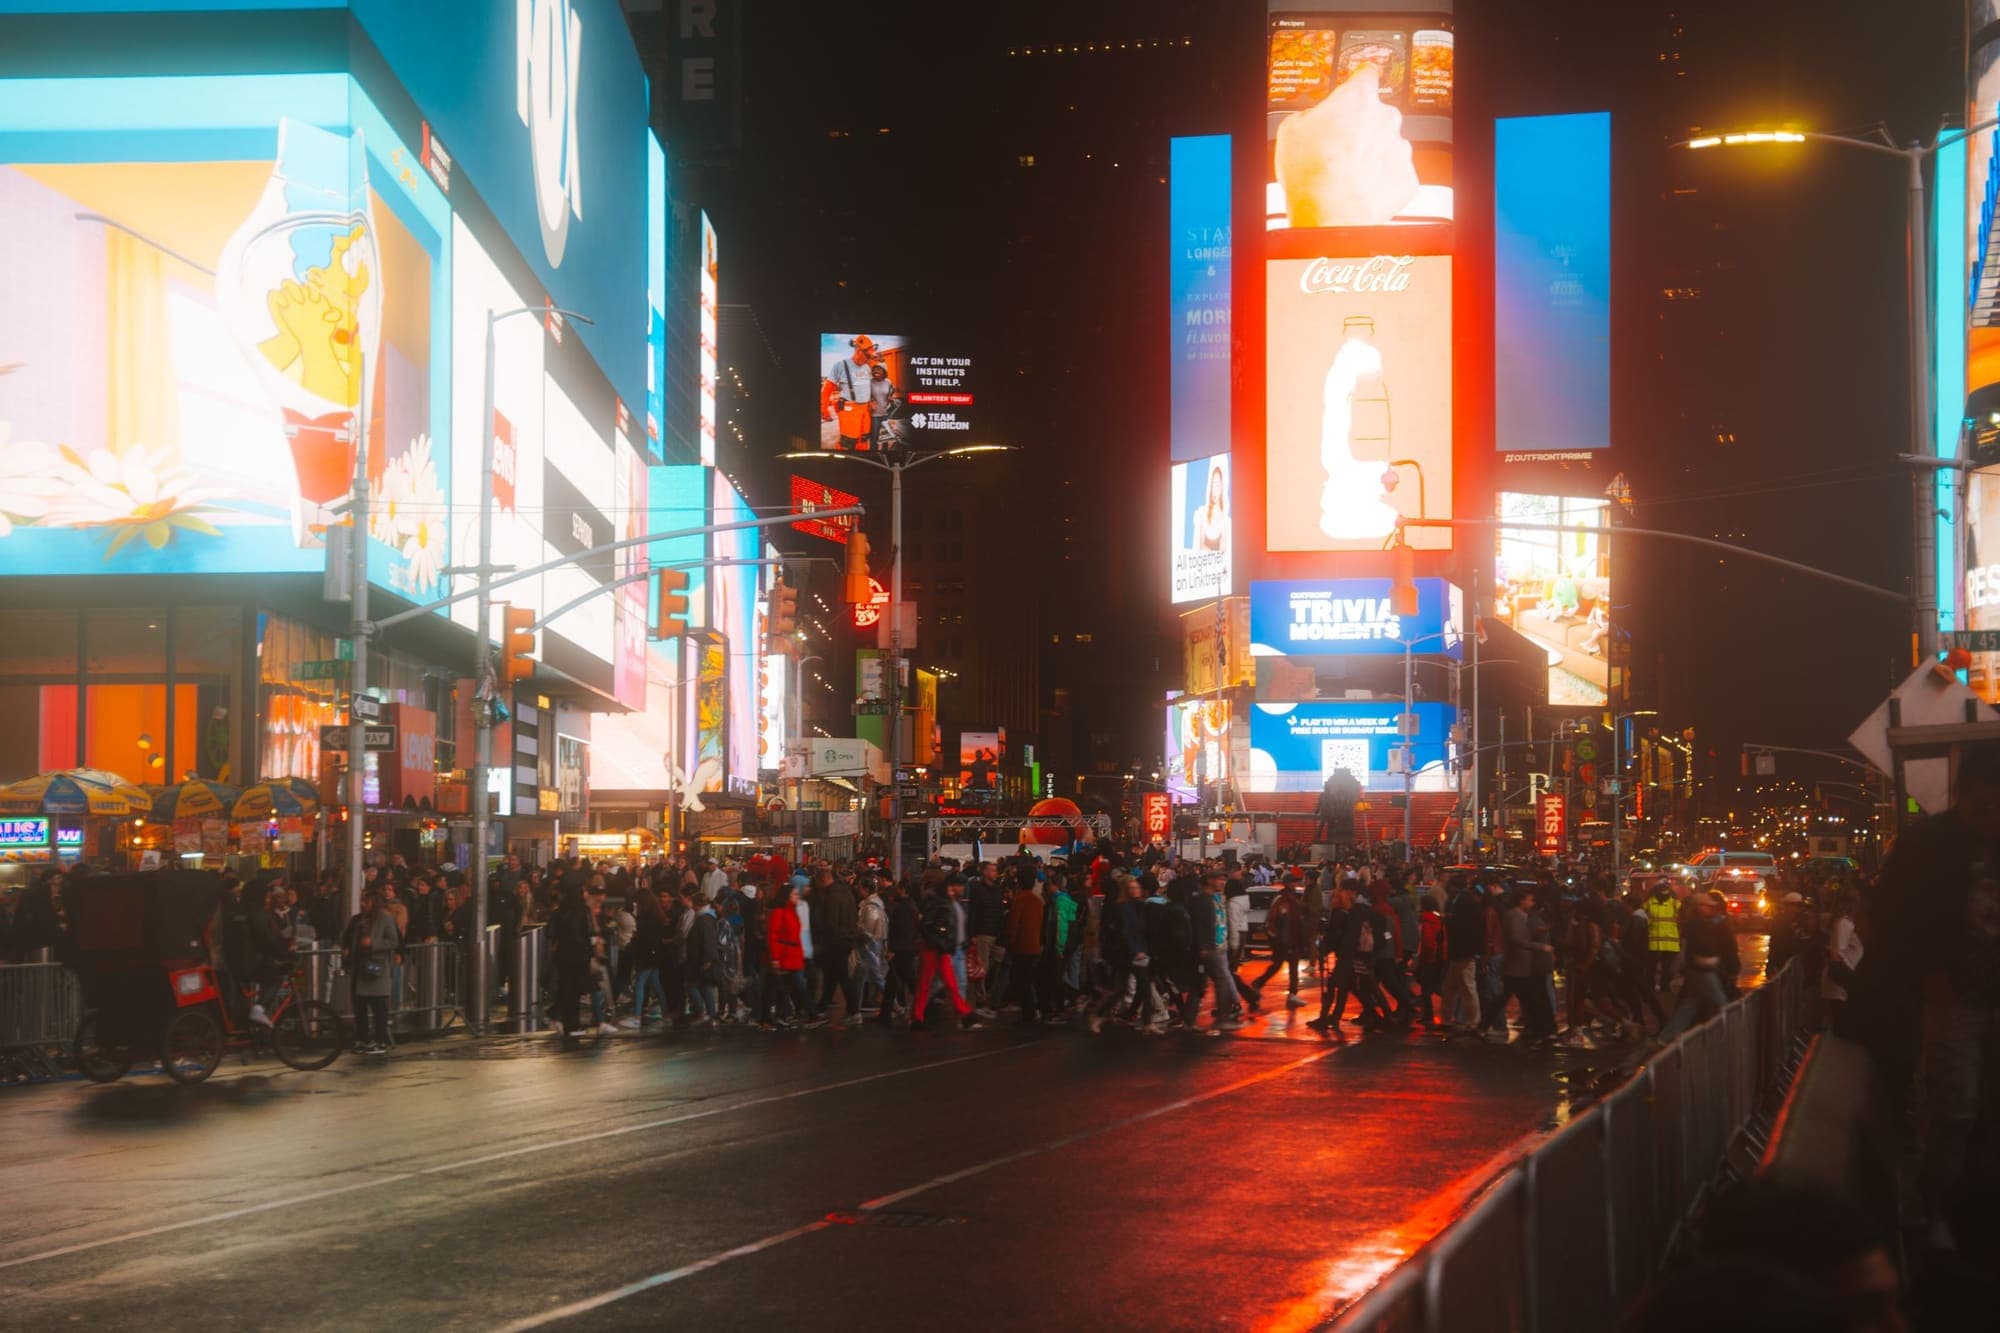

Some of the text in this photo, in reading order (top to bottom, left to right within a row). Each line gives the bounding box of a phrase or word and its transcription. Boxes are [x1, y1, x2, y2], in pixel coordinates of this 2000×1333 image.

[1187, 246, 1231, 260] LONGE
[1300, 255, 1415, 294] Coca-Cola
[910, 357, 971, 367] ACT ON YOUR
[916, 367, 966, 377] INSTINCTS
[920, 378, 961, 387] TO HELP.
[927, 412, 956, 421] TEAM
[927, 421, 970, 431] RUBICON
[1504, 451, 1593, 464] #OUTFRONTPRIME
[1176, 550, 1225, 573] All together
[1176, 575, 1187, 591] on
[1290, 598, 1400, 624] TRIVIA
[1289, 623, 1401, 641] MOMENTS
[1300, 718, 1324, 727] PLAY
[1324, 718, 1334, 726] TO
[1355, 718, 1378, 726] WEEK
[1378, 717, 1390, 726] OF
[1290, 726, 1311, 735] FREE
[1312, 726, 1329, 735] BUS
[1330, 726, 1341, 735] OR
[1342, 726, 1375, 735] SUBWAY
[1150, 796, 1168, 831] tkts
[1544, 796, 1563, 834] tkts
